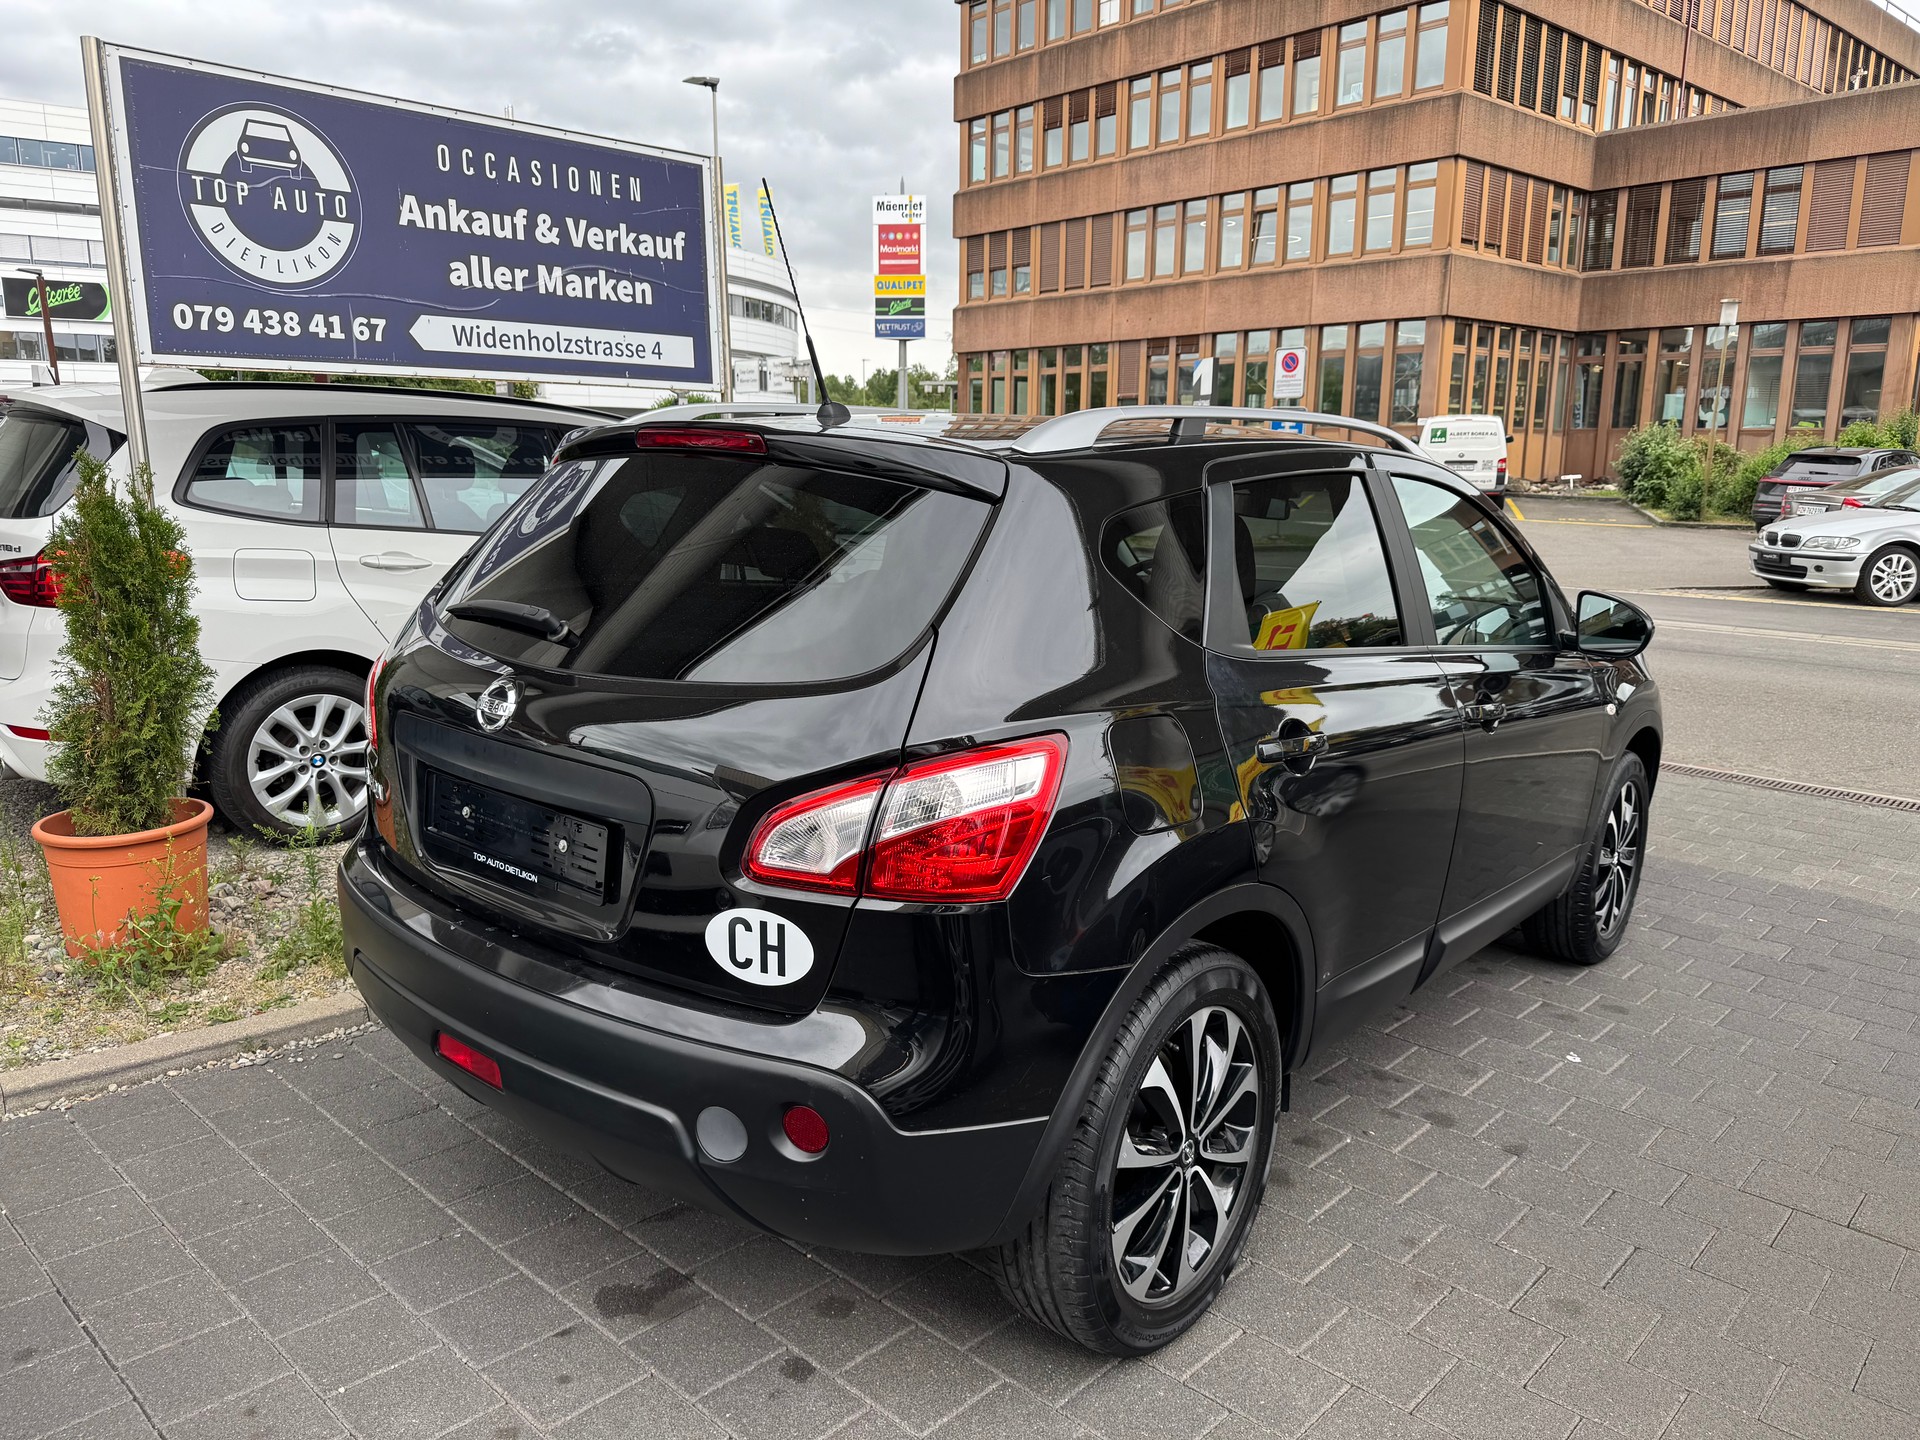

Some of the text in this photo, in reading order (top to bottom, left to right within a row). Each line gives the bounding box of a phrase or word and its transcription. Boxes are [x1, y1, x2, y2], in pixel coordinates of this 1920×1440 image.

[437, 144, 641, 202] OCCASIONEN
[192, 175, 347, 218] TOP AUTO
[877, 200, 922, 211] Mäenriet
[399, 194, 686, 261] Ankauf & Verkauf
[211, 223, 341, 274] DIETLIKON
[880, 244, 919, 254] Maximarkt
[449, 254, 653, 305] aller Marken
[876, 280, 924, 290] QUALIPET
[172, 303, 386, 342] 079 438 41 67
[451, 324, 663, 360] Widenholzstrasse 4
[473, 852, 538, 883] TOP AUTO DIETLIKON
[728, 916, 786, 977] CH
